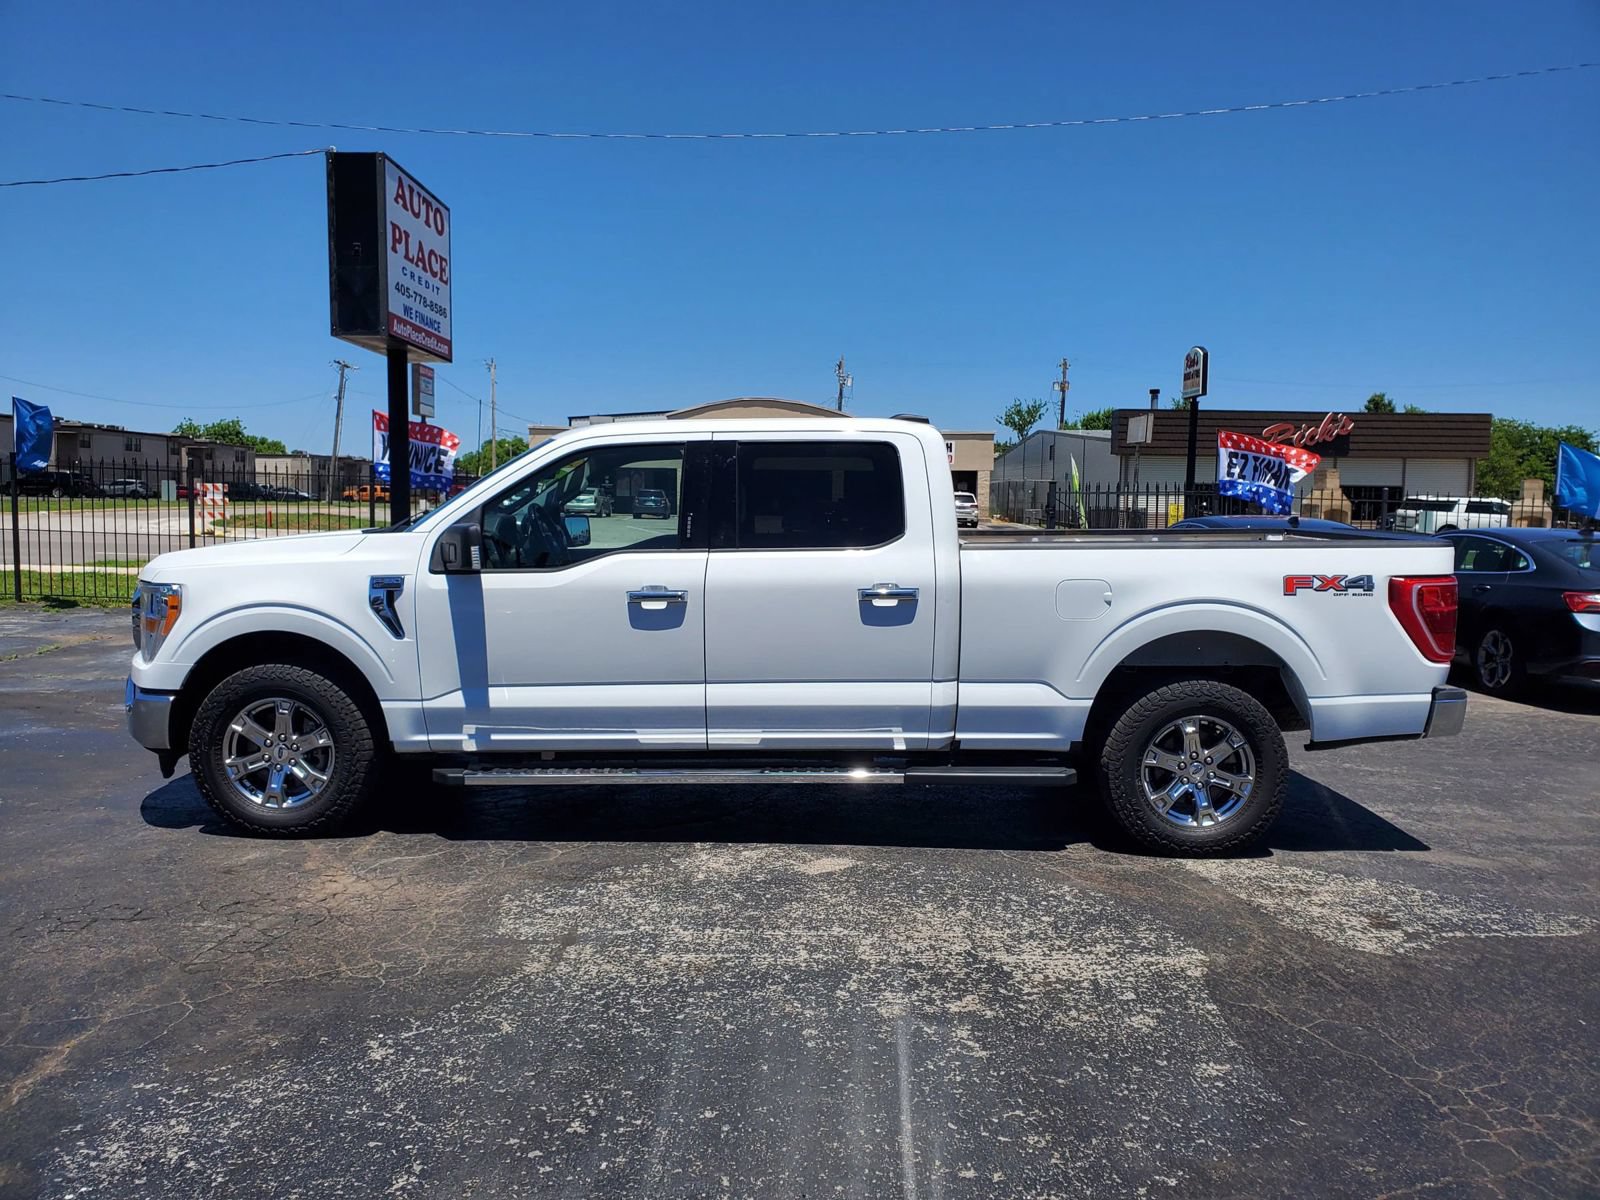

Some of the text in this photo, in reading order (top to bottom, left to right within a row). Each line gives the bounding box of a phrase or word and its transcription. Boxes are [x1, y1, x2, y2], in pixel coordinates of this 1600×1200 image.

[394, 175, 445, 237] AUTO
[390, 220, 449, 286] PLACE
[401, 266, 440, 296] CREDIT
[402, 303, 441, 334] WE FINANCE
[1262, 411, 1355, 447] Rick's
[1226, 451, 1250, 480] EZ
[1283, 574, 1375, 596] FX4
